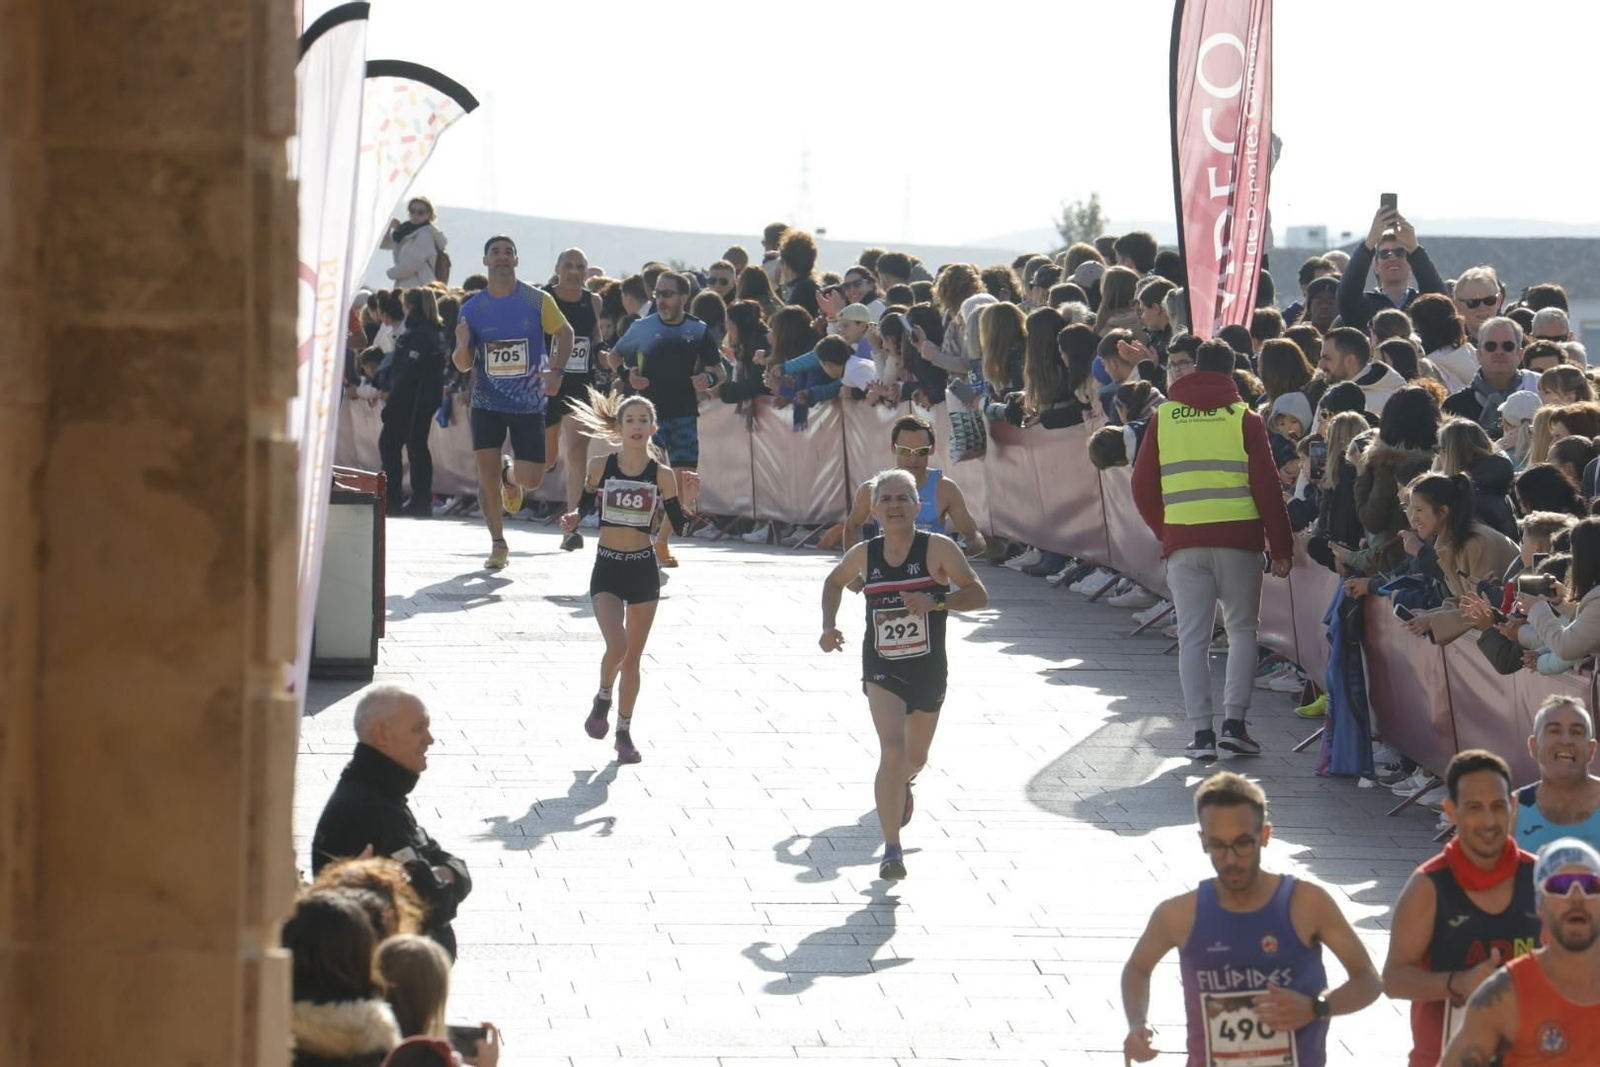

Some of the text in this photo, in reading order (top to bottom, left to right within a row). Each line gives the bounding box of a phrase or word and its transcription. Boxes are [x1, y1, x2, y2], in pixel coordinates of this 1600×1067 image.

[493, 350, 520, 363] 705
[571, 348, 586, 358] 50
[615, 492, 644, 509] 168
[599, 548, 651, 561] NIKE PRO
[884, 622, 919, 640] 292
[1196, 964, 1292, 991] FILÍPIDES
